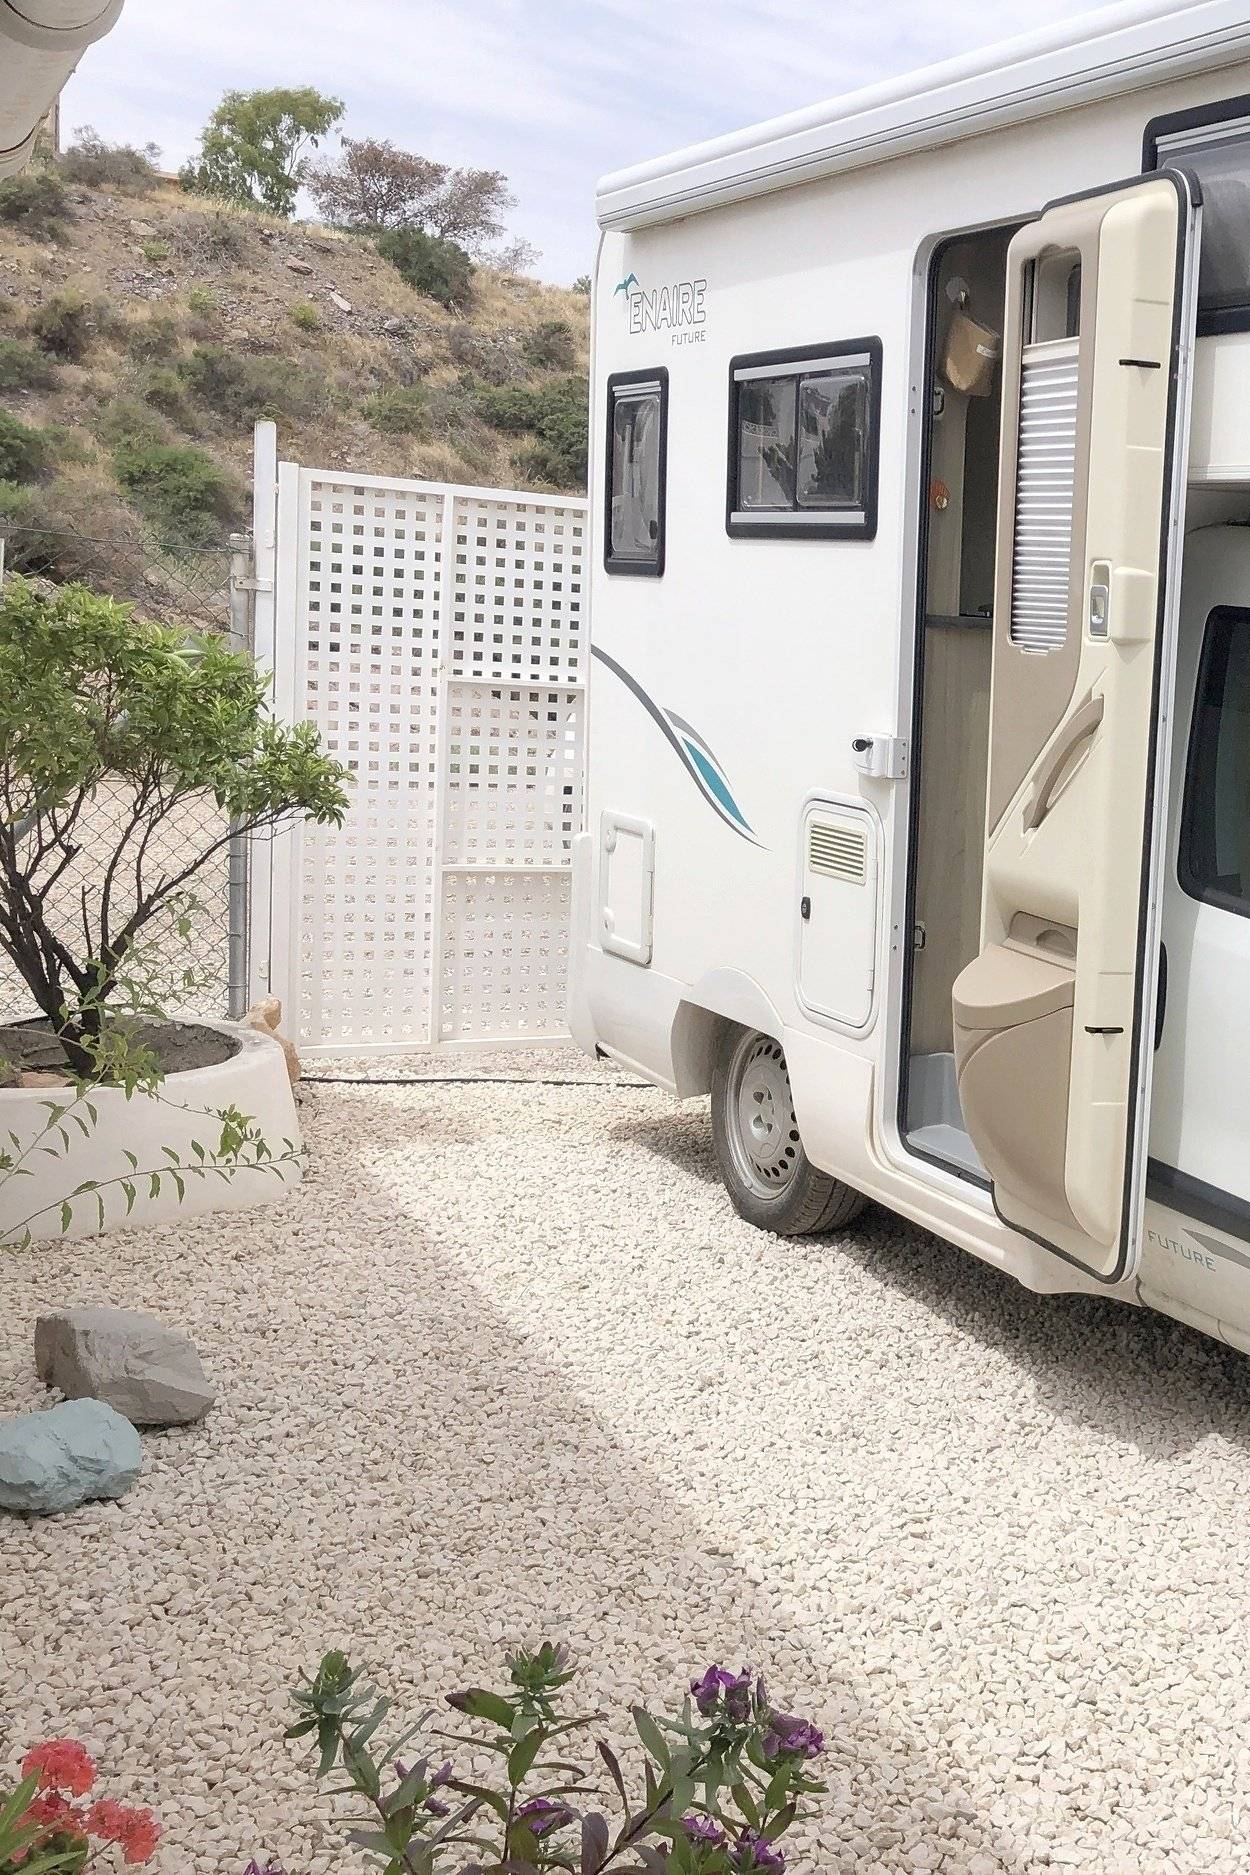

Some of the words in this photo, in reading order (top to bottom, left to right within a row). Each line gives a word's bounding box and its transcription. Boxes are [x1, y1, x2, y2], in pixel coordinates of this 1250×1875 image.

[629, 279, 708, 335] ENAIRE
[671, 330, 707, 346] FUTURE
[1147, 1230, 1216, 1273] FUTURE
